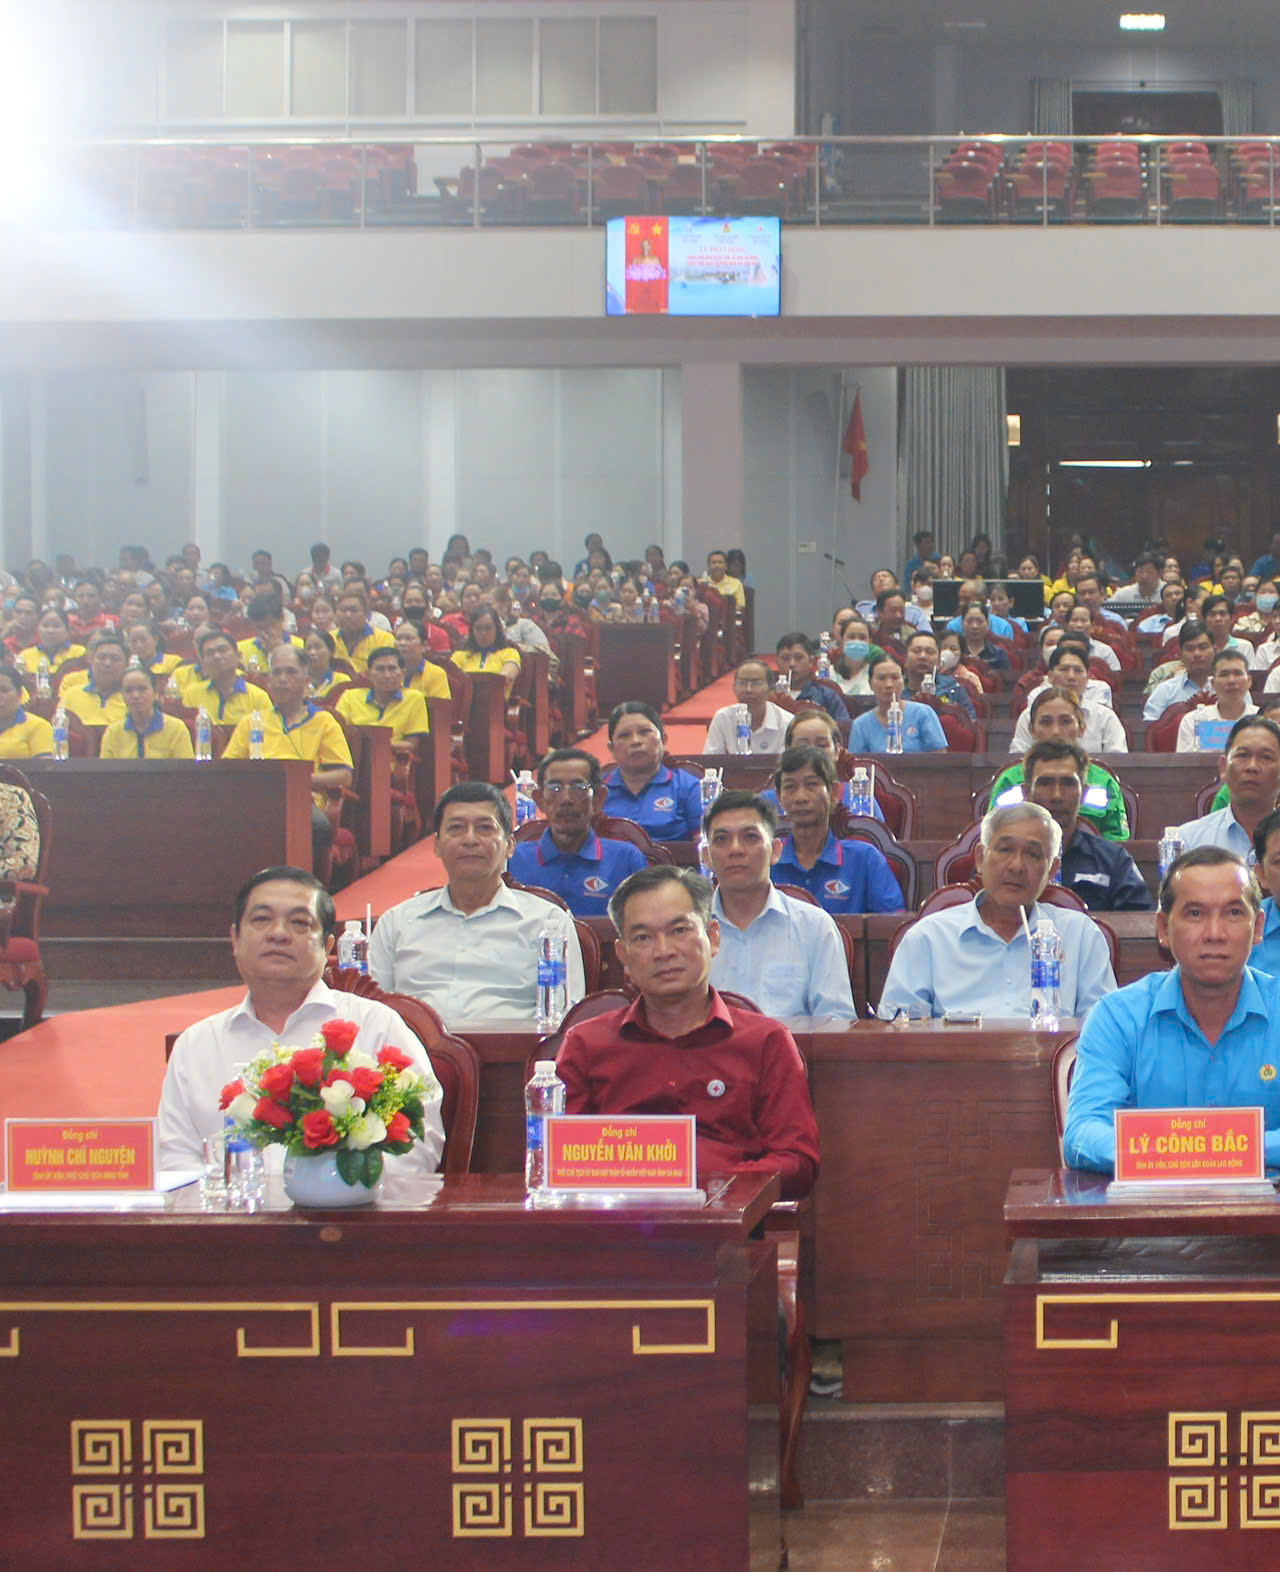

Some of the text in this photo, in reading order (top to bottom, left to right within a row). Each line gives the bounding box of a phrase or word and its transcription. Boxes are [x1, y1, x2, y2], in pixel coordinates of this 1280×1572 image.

[602, 1125, 637, 1139] Đồng chí
[1171, 1117, 1206, 1130] Đồng chí
[562, 1138, 615, 1161] NGUYỄN
[617, 1141, 643, 1161] VĂN
[1129, 1129, 1249, 1155] LÝ CÔNG BẮC
[67, 1145, 87, 1165] CHÍ
